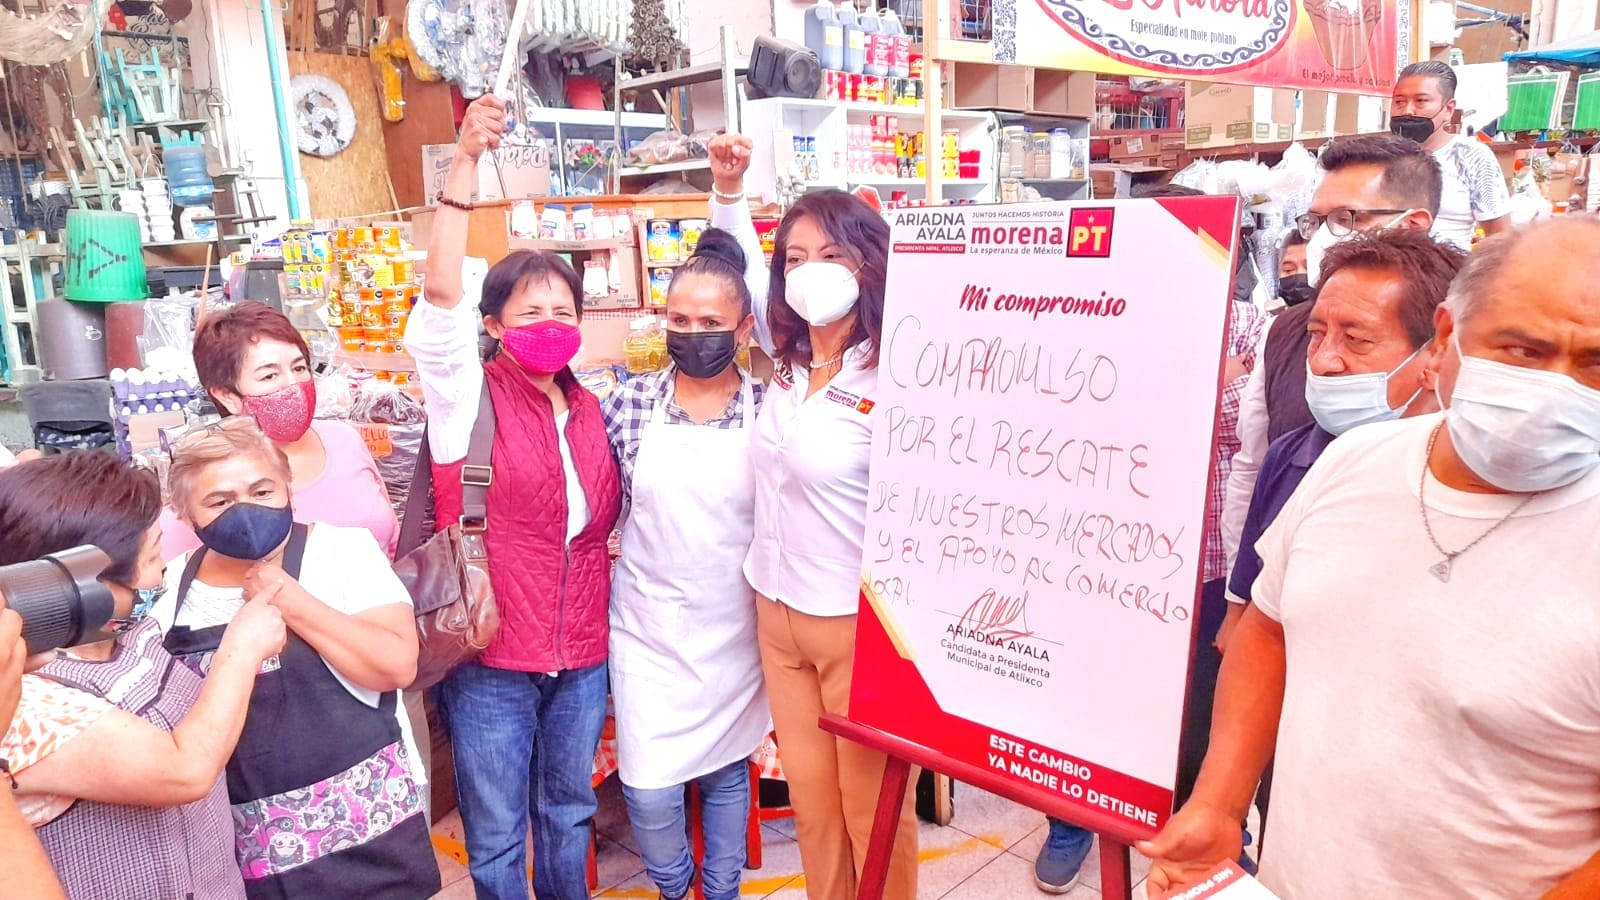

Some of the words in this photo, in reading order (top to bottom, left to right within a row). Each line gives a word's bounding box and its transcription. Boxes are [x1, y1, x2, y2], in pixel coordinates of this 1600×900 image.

[1130, 19, 1178, 38] Especialidad
[1180, 29, 1188, 39] en
[1190, 29, 1207, 42] mole
[1209, 32, 1237, 45] poblano
[895, 213, 966, 226] ARIADNA
[1032, 210, 1064, 218] HISTORIA
[916, 228, 966, 240] AYALA
[970, 246, 979, 254] La
[981, 247, 1018, 255] esperanza
[1020, 246, 1030, 254] de
[1033, 246, 1063, 255] México
[971, 225, 1063, 244] morena
[1072, 226, 1107, 250] PT
[959, 284, 991, 311] Mi
[994, 291, 1126, 321] compromiso
[826, 390, 857, 407] morena
[885, 405, 936, 461] POR
[949, 416, 978, 464] EL
[990, 420, 1150, 498] RESCATE
[873, 481, 900, 512] DE
[910, 486, 1049, 539] NUESTROS
[1056, 508, 1185, 580] MERCADOS
[902, 538, 924, 563] EL
[938, 535, 1016, 575] APOYO
[1066, 565, 1189, 623] COMERCIO
[940, 638, 987, 659] Candidata
[998, 655, 1050, 678] Presidenta
[946, 624, 1004, 648] ARIADNA
[1008, 641, 1050, 662] AYALA
[947, 651, 991, 672] Municipal
[994, 667, 1006, 676] de
[1009, 671, 1043, 687] Atlixco
[989, 734, 1025, 757] ESTE
[1028, 749, 1091, 780] CAMBIO
[987, 752, 1006, 770] YA
[1010, 763, 1058, 789] NADIE
[1062, 780, 1083, 798] LO
[1087, 789, 1158, 827] DETIENE
